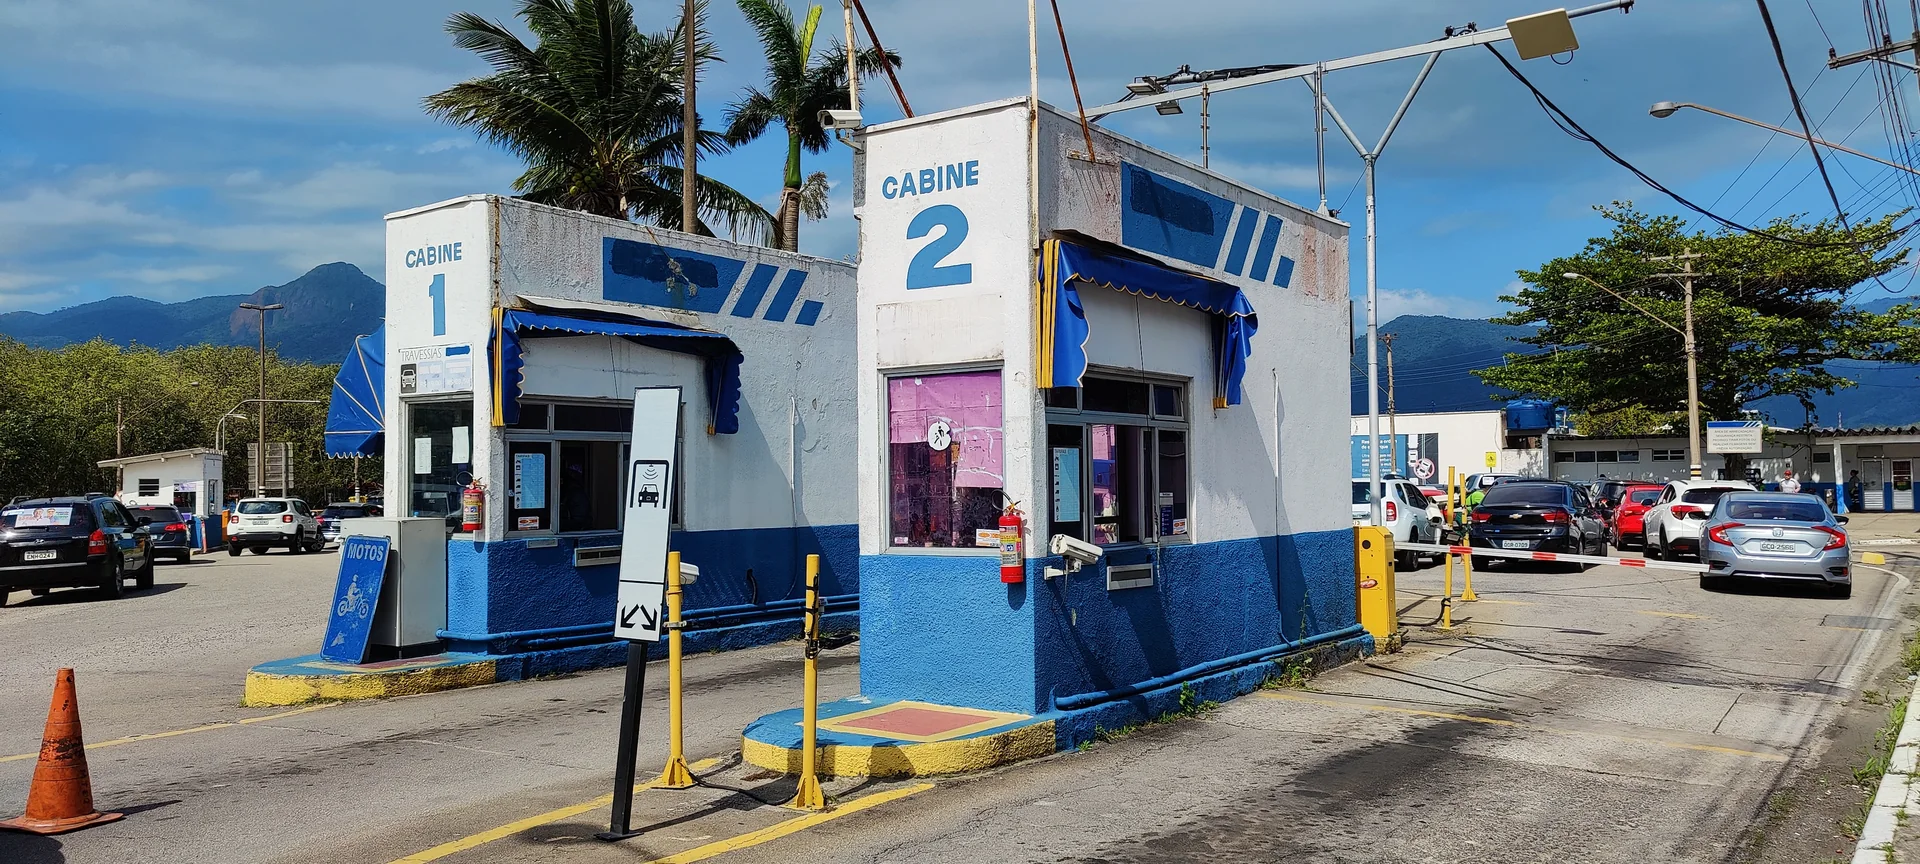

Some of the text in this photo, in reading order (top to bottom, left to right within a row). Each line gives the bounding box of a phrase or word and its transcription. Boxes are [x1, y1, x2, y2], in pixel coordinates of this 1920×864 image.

[881, 159, 979, 200] CABINE
[405, 241, 462, 269] CABINE
[906, 203, 972, 291] 2
[428, 273, 446, 337] 1
[401, 347, 442, 361] TRAVESSIAS
[347, 542, 384, 562] MOTOS
